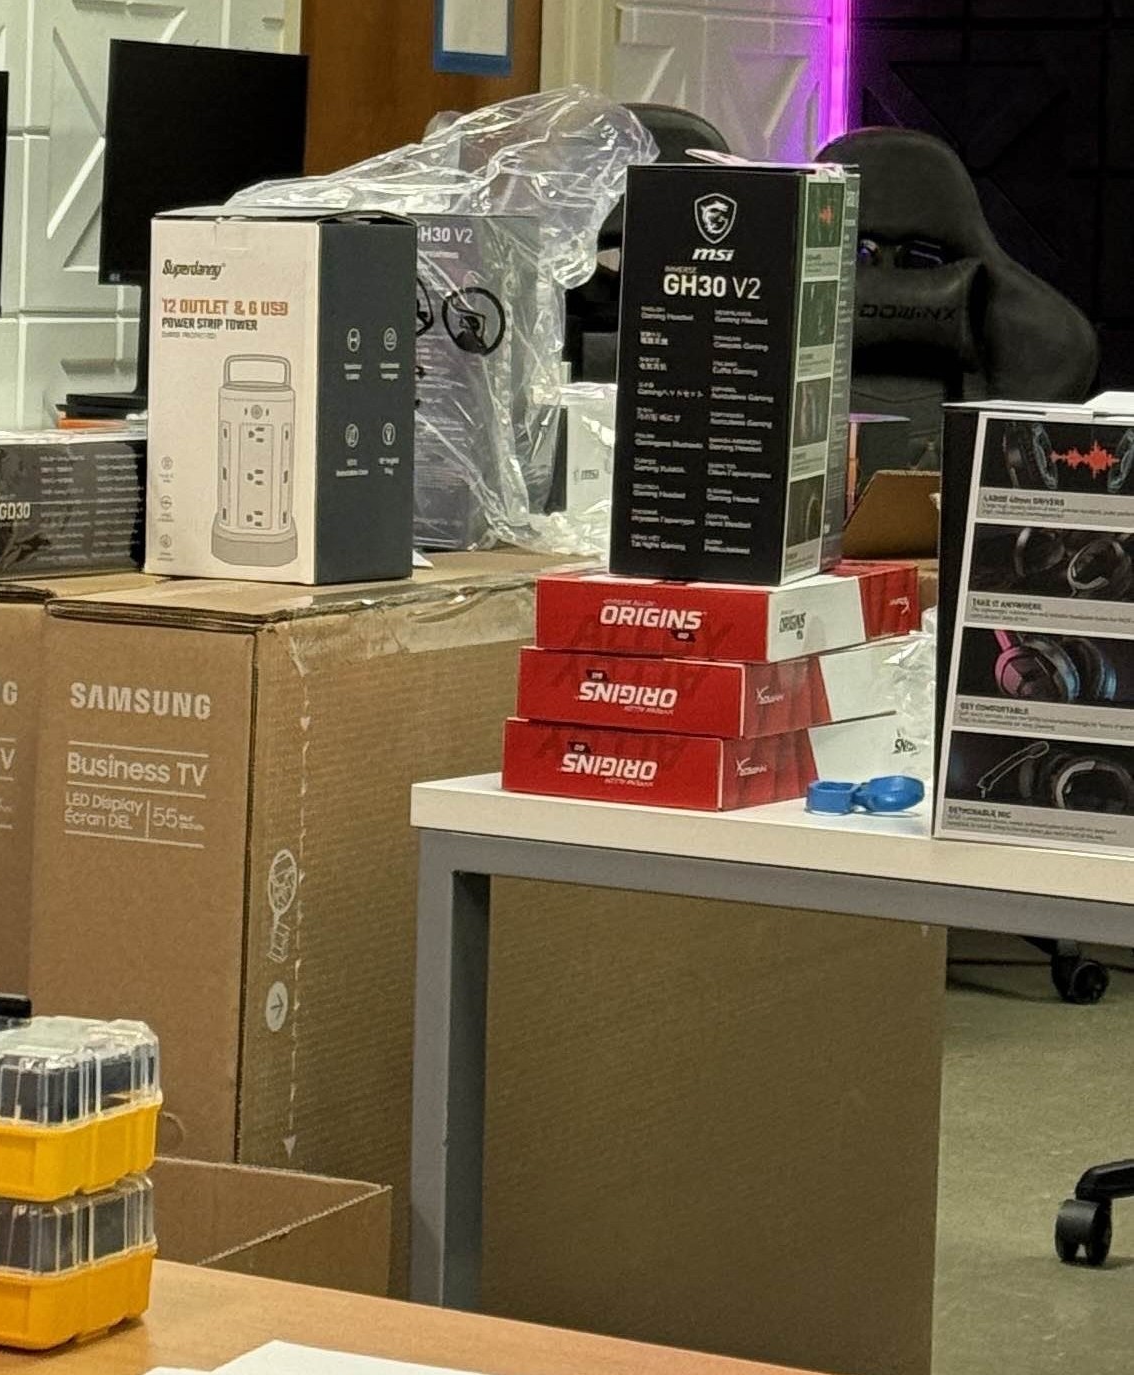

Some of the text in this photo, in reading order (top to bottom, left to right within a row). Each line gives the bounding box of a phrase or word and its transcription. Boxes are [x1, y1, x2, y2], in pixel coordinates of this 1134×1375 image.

[454, 228, 473, 243] V2
[691, 248, 735, 261] msi
[663, 273, 761, 299] GH30 V2
[162, 297, 176, 314] 12
[179, 299, 229, 315] OUTLET
[233, 300, 245, 315] &
[162, 317, 258, 331] POWER STRIP TOWER
[600, 605, 704, 630] ORIGINS
[70, 682, 211, 720] SAMSUNG
[577, 681, 678, 708] ORIGINS
[67, 751, 208, 786] Business TV
[560, 753, 658, 781] ORIGINS
[66, 792, 143, 816] LED Display
[152, 807, 178, 829] 55
